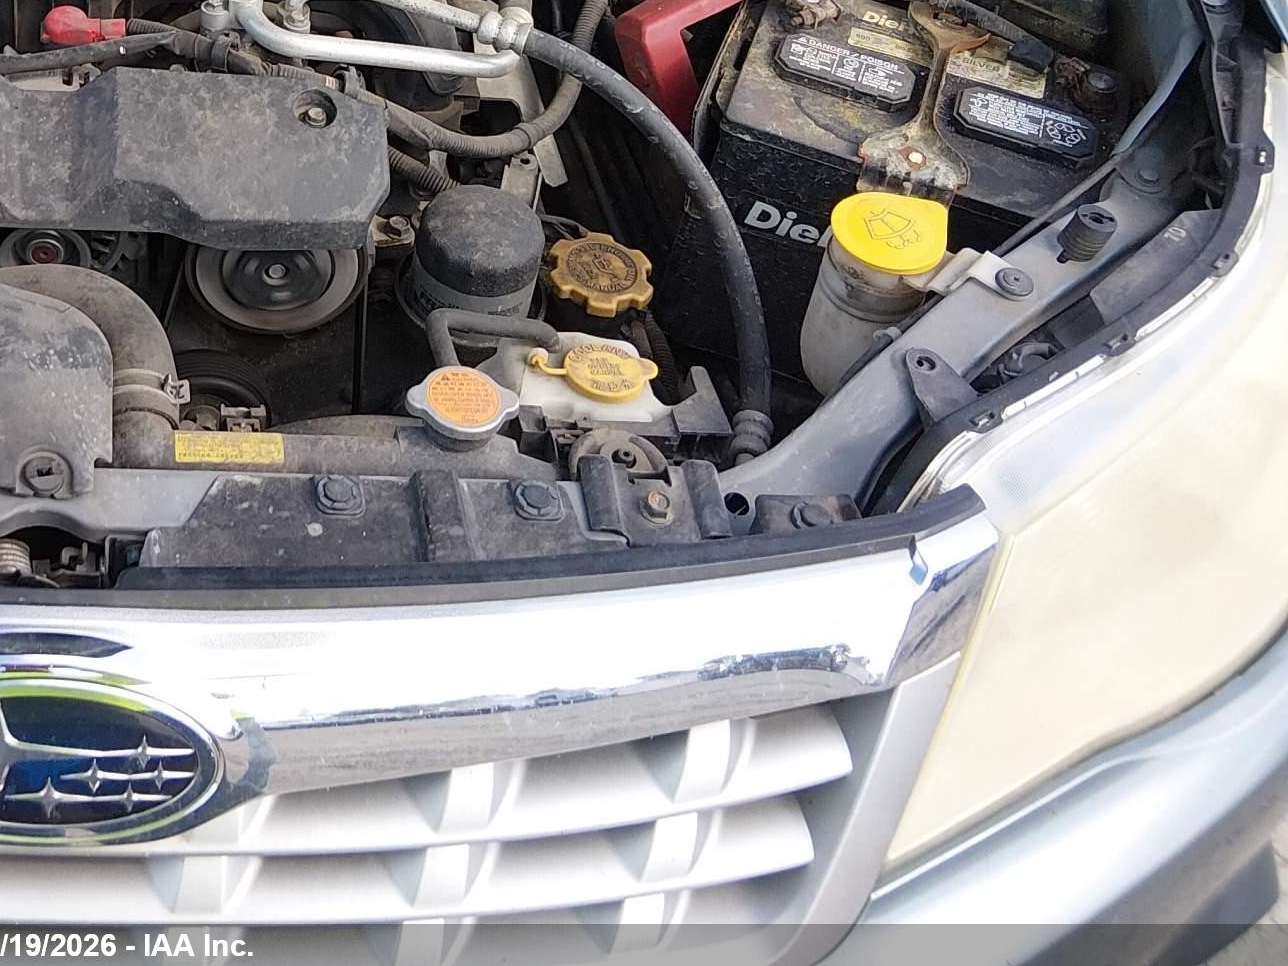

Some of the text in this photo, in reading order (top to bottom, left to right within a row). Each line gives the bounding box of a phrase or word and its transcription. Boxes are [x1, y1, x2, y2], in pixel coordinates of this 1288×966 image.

[809, 39, 851, 56] DANGER
[860, 54, 900, 70] POISON
[961, 56, 1001, 73] SILVER
